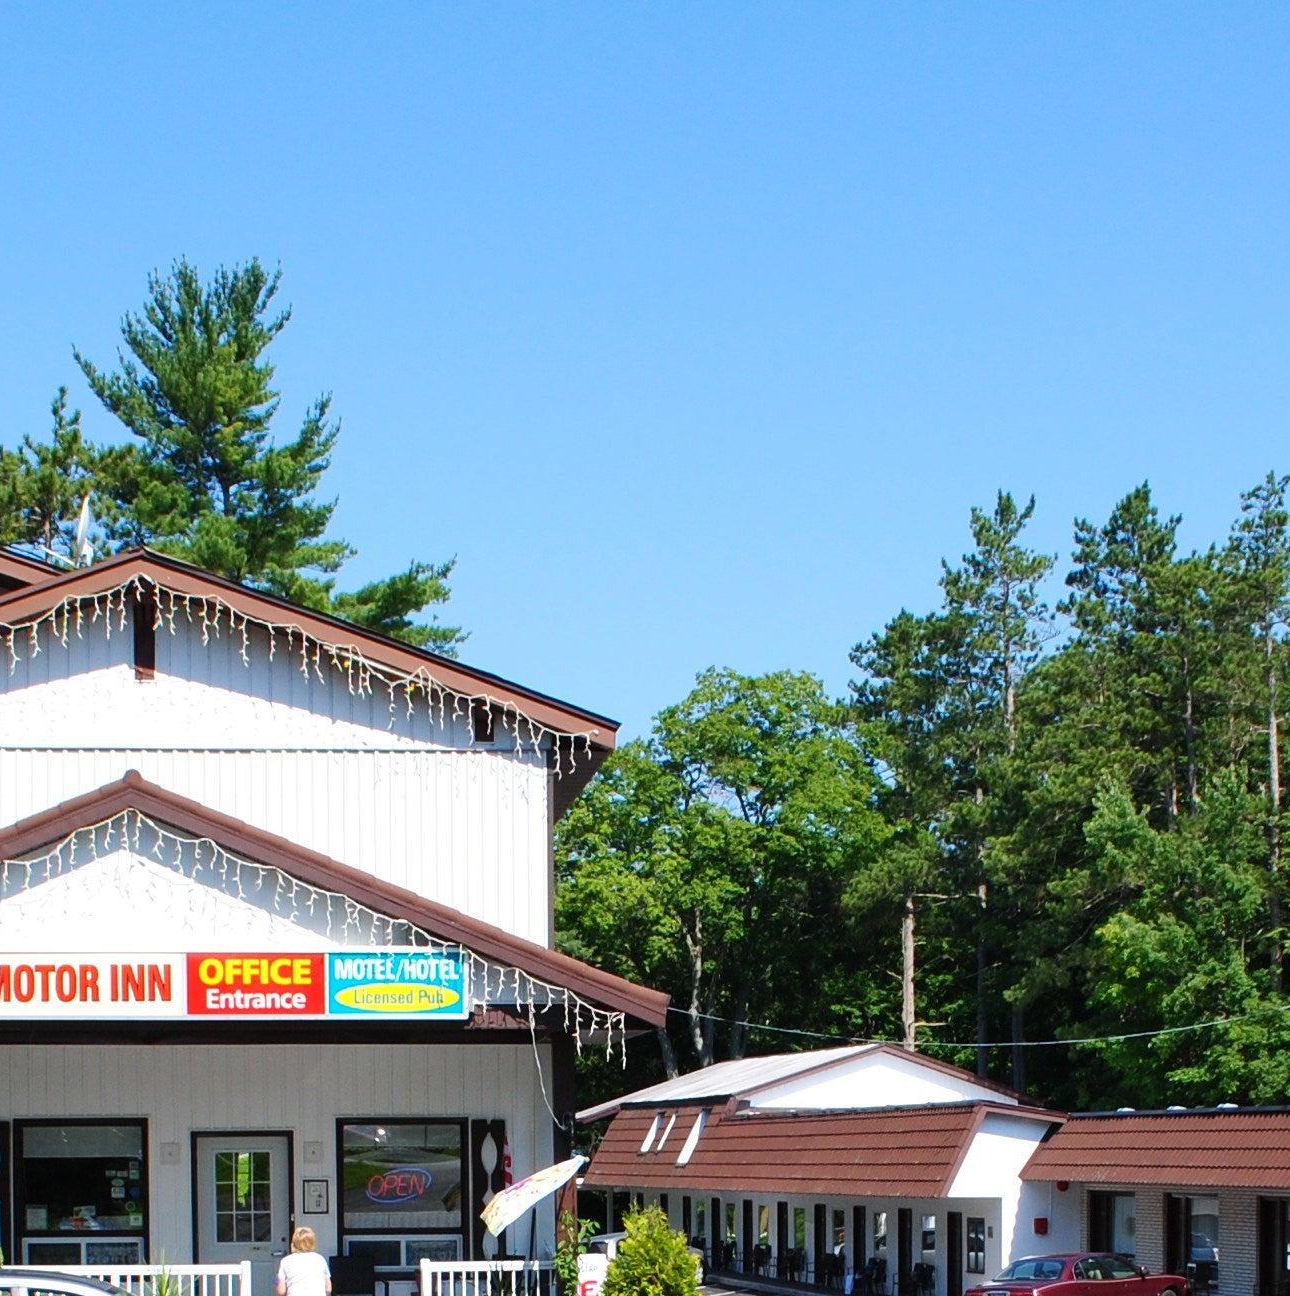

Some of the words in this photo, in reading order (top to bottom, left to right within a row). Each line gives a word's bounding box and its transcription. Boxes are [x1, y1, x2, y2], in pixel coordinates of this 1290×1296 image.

[198, 958, 312, 986] OFFICE
[334, 958, 459, 982] MOTEL/HOTEL
[110, 964, 172, 1003] INN
[205, 989, 306, 1010] Entrance
[354, 989, 413, 1005] Licensed
[419, 990, 444, 1005] Pub
[367, 1175, 427, 1198] OPEN
